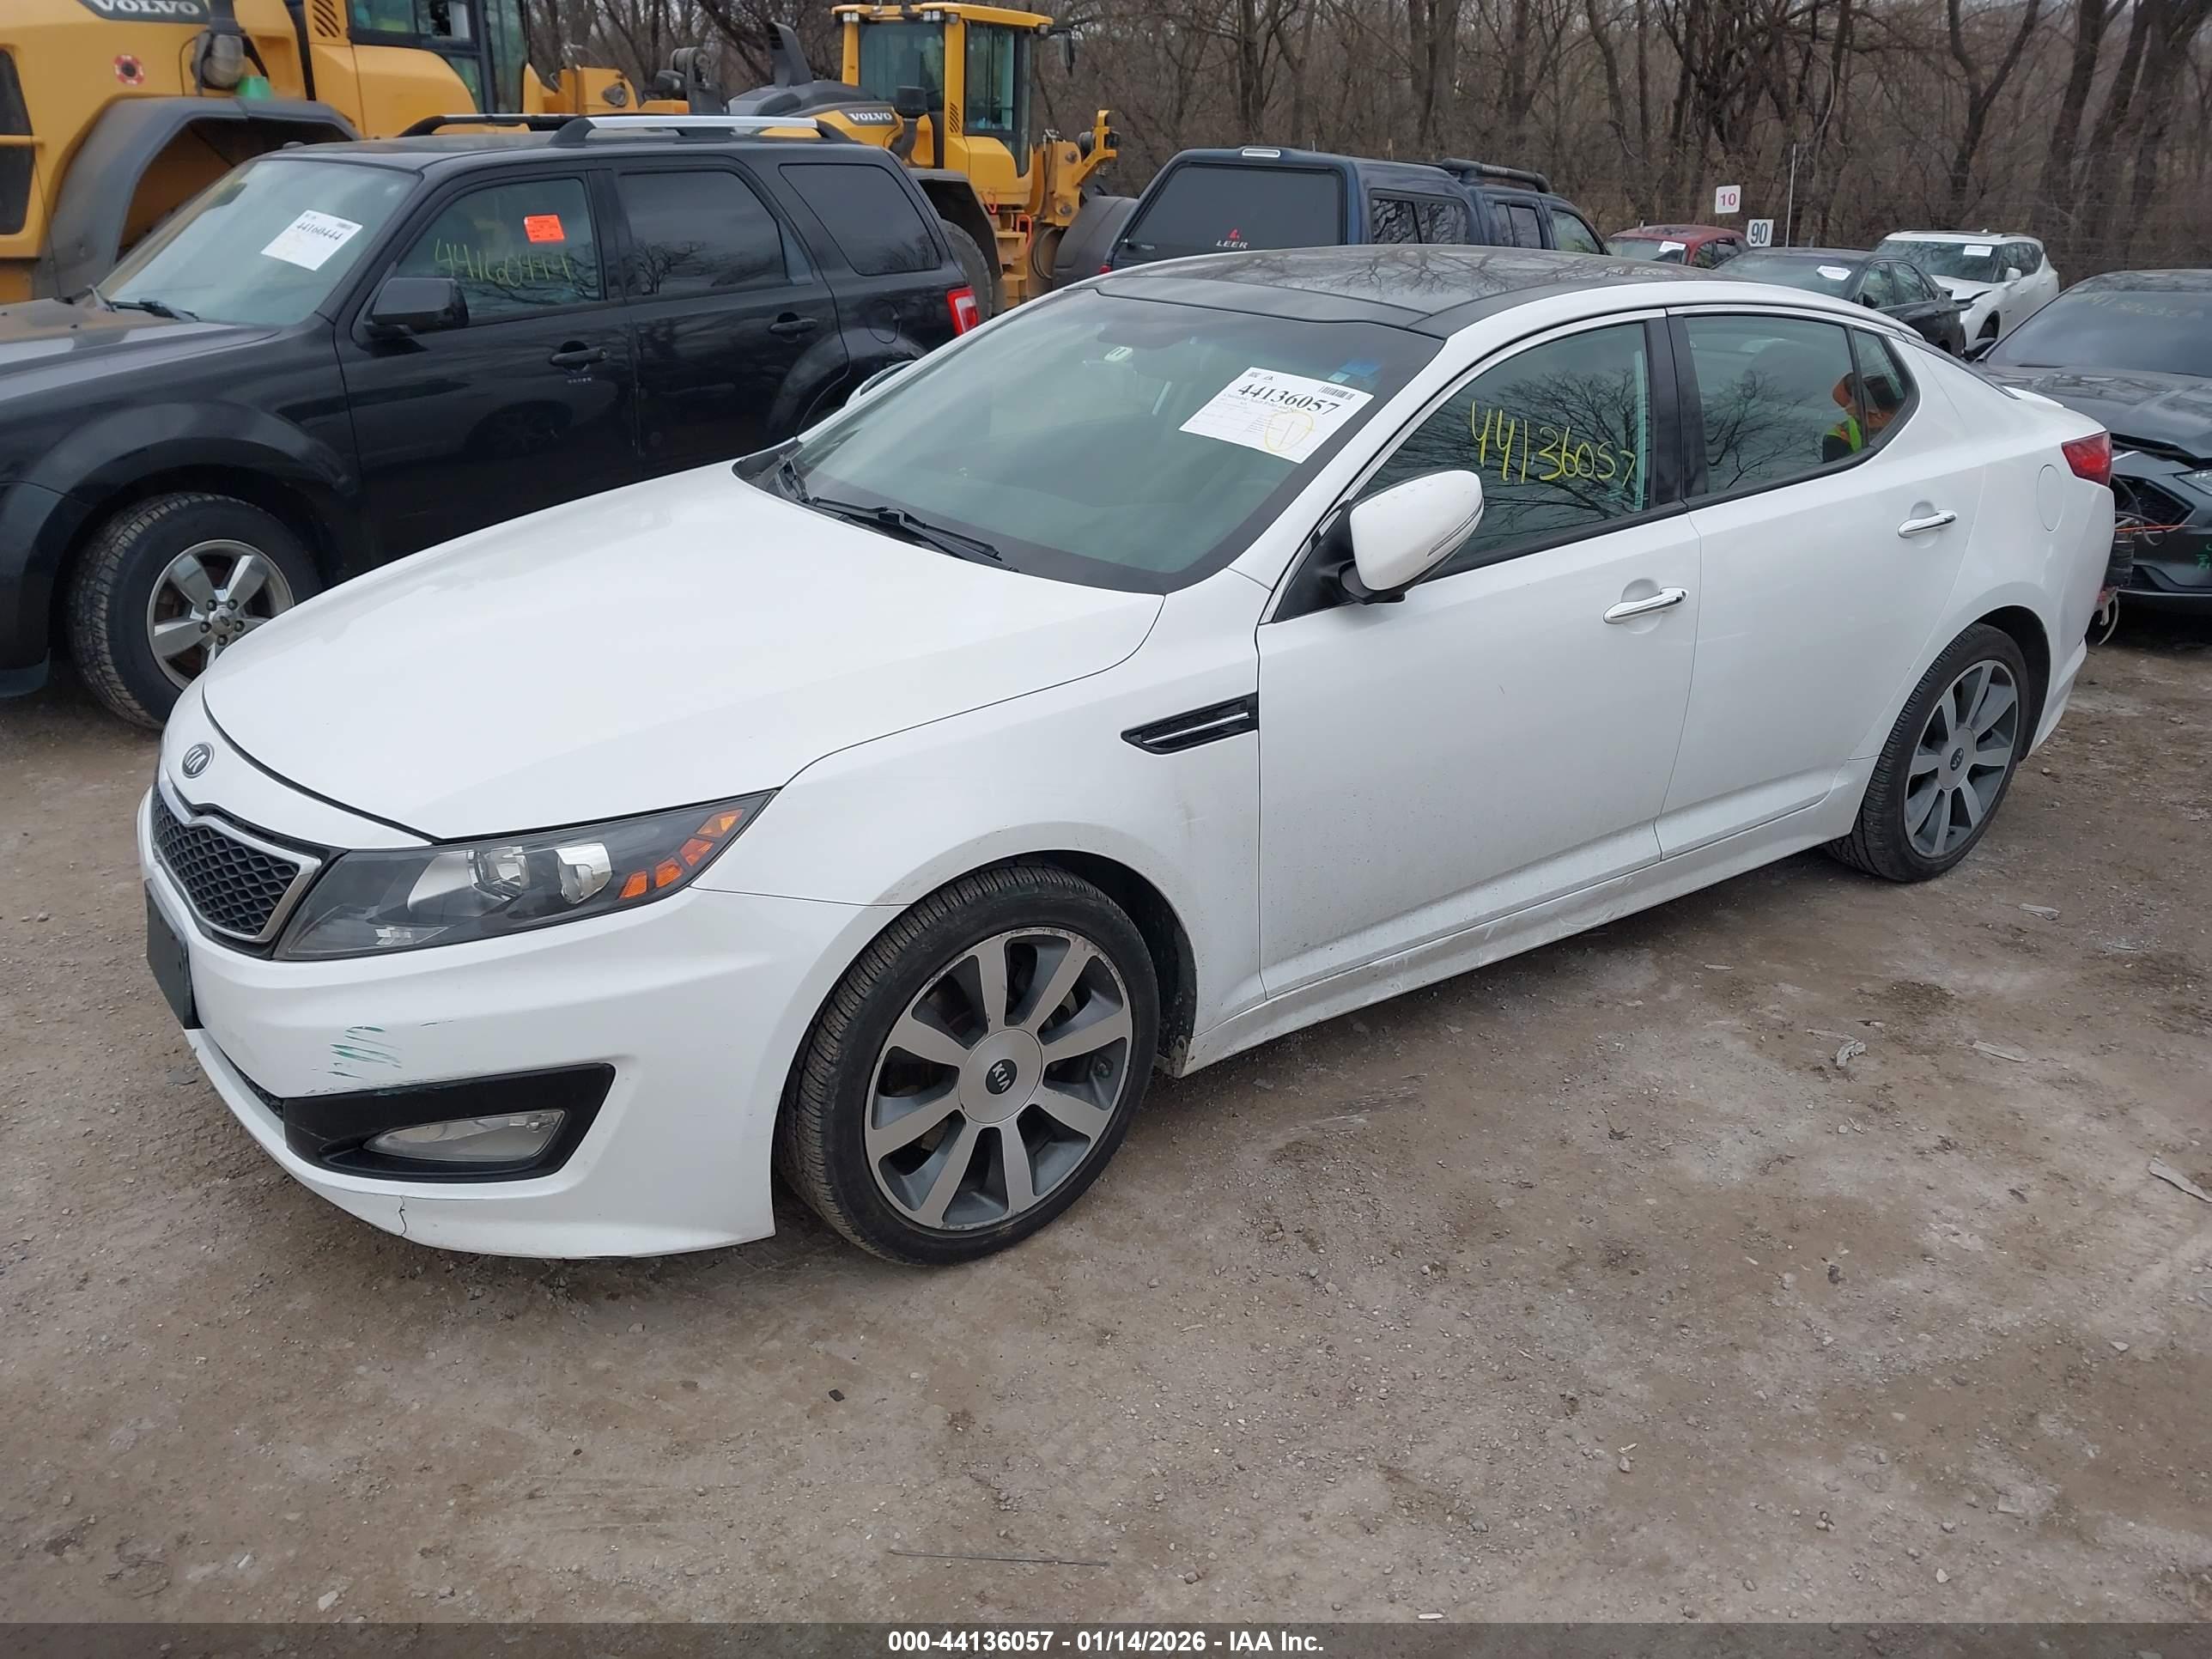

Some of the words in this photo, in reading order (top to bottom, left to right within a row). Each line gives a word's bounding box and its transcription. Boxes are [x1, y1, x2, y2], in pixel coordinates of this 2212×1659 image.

[93, 0, 199, 15] VOLVO
[848, 112, 893, 121] VOLVO
[1720, 192, 1737, 207] 10
[1215, 240, 1249, 249] LEER
[1751, 222, 1769, 245] 90
[1237, 383, 1340, 416] 44136057
[1471, 400, 1637, 487] 44136057
[184, 746, 207, 774] KIA
[991, 1062, 1011, 1091] KIA
